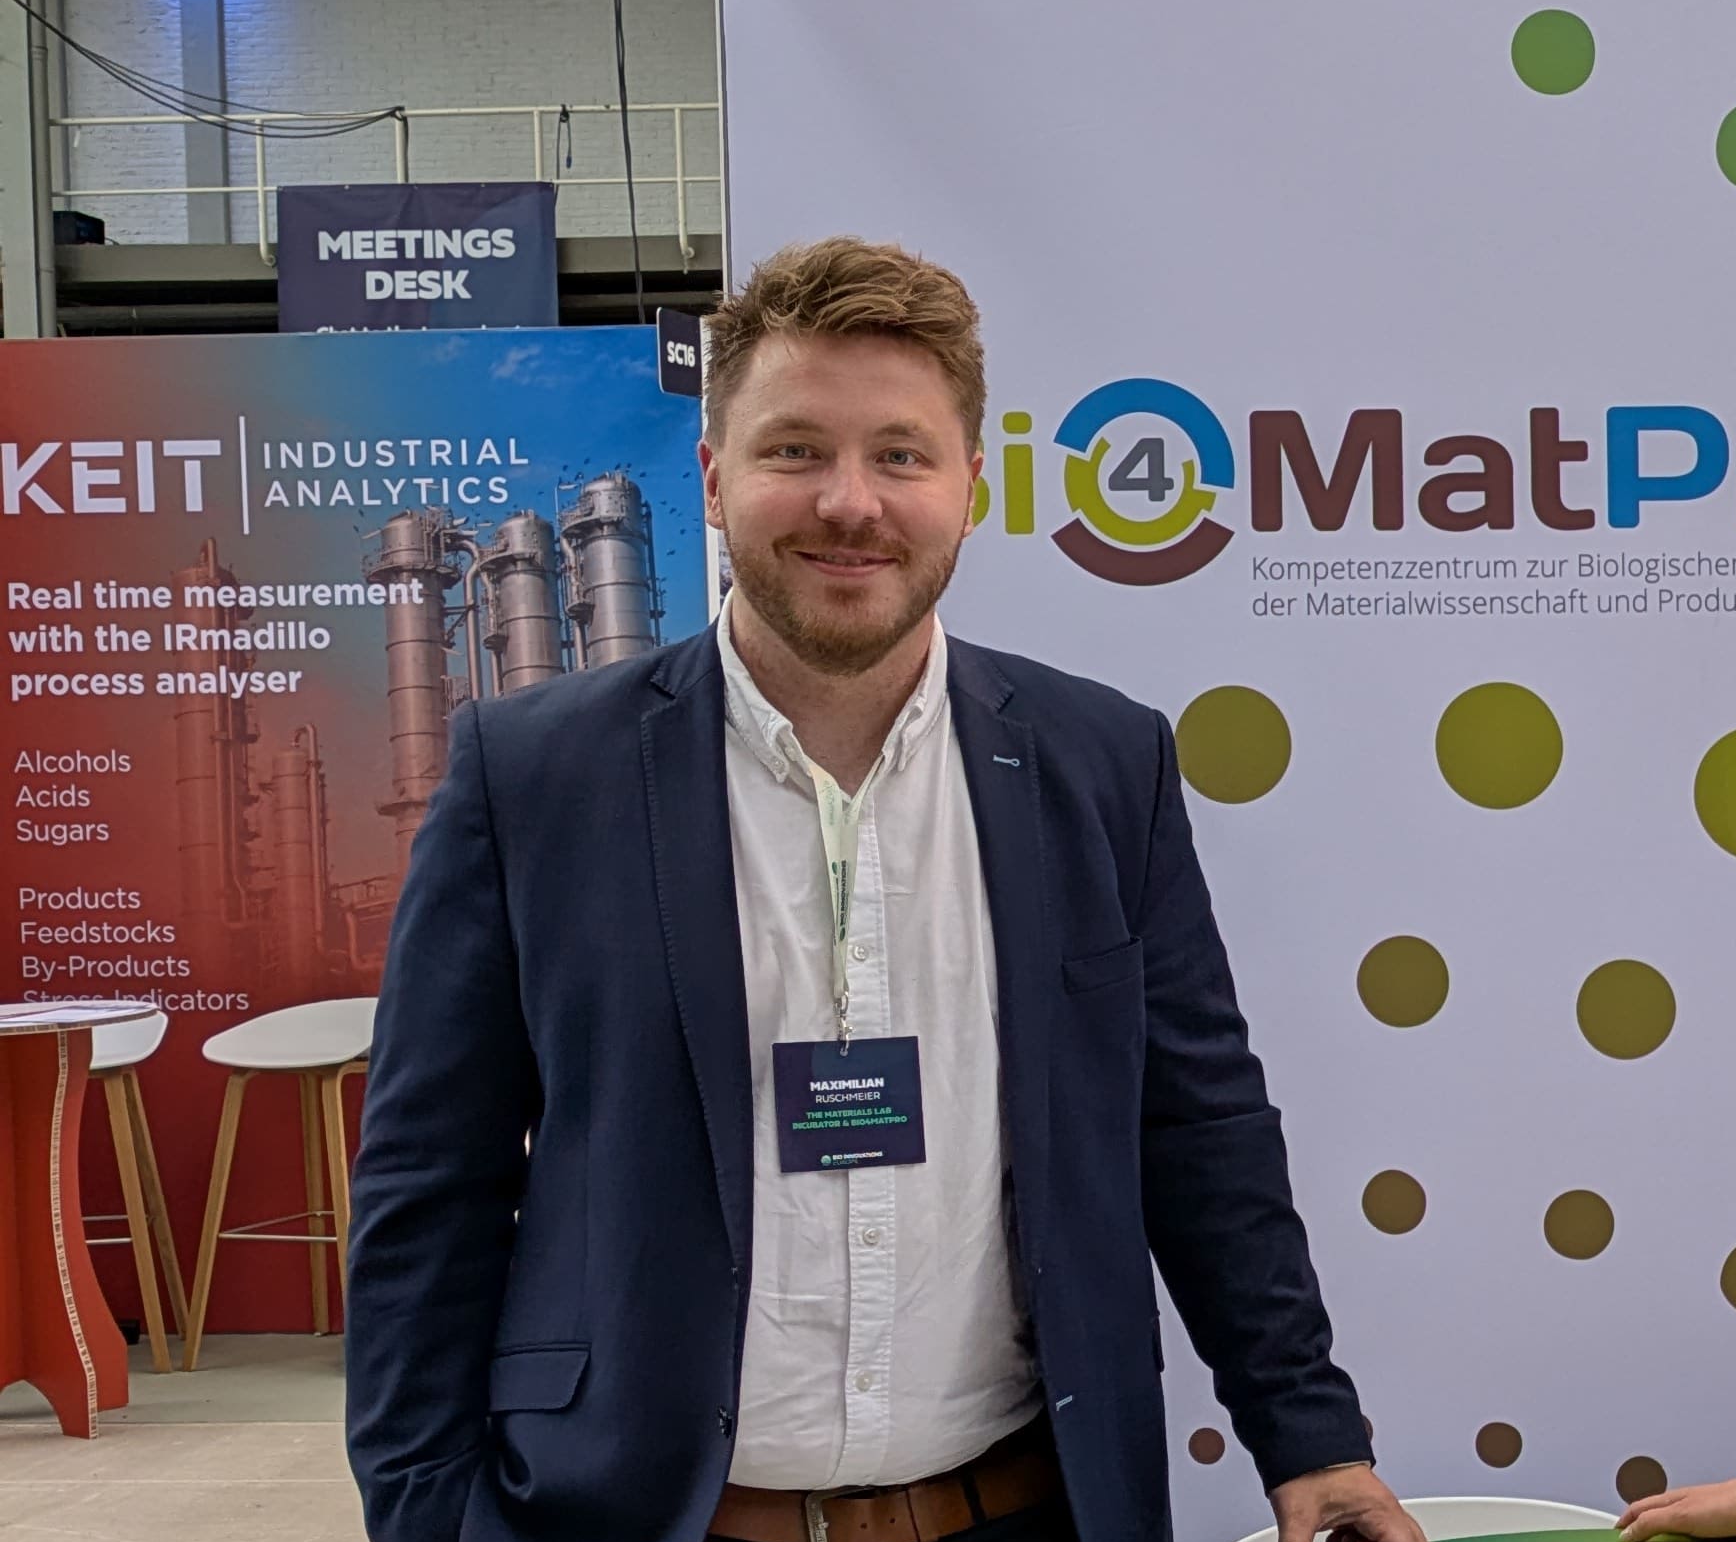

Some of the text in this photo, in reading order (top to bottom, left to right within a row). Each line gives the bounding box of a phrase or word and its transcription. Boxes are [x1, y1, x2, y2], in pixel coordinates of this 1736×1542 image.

[317, 228, 516, 261] MEETINGS
[364, 270, 473, 300] DESK
[666, 340, 697, 369] SC16
[263, 438, 530, 469] INDUSTRIAL
[1, 440, 222, 515] KEIT
[264, 476, 509, 508] ANALYTICS
[1251, 553, 1519, 587] Kompetenzzentrum
[1525, 558, 1571, 580] zur
[7, 578, 425, 611] Real time measurement
[1251, 590, 1298, 617] der
[1304, 587, 1589, 617] Materialwissenschaft
[1596, 588, 1649, 614] und
[9, 620, 331, 654] with the IRmadillo
[11, 665, 302, 701] process analyser
[14, 749, 132, 775] Alcohols
[15, 783, 91, 808] Acids
[16, 819, 110, 847] Sugars
[19, 886, 141, 911] Products
[20, 920, 176, 945] Feedstocks
[21, 955, 191, 982] By-Products
[809, 1077, 885, 1092] MAXIMILIAN
[815, 1091, 881, 1104] RUSCHMEIER
